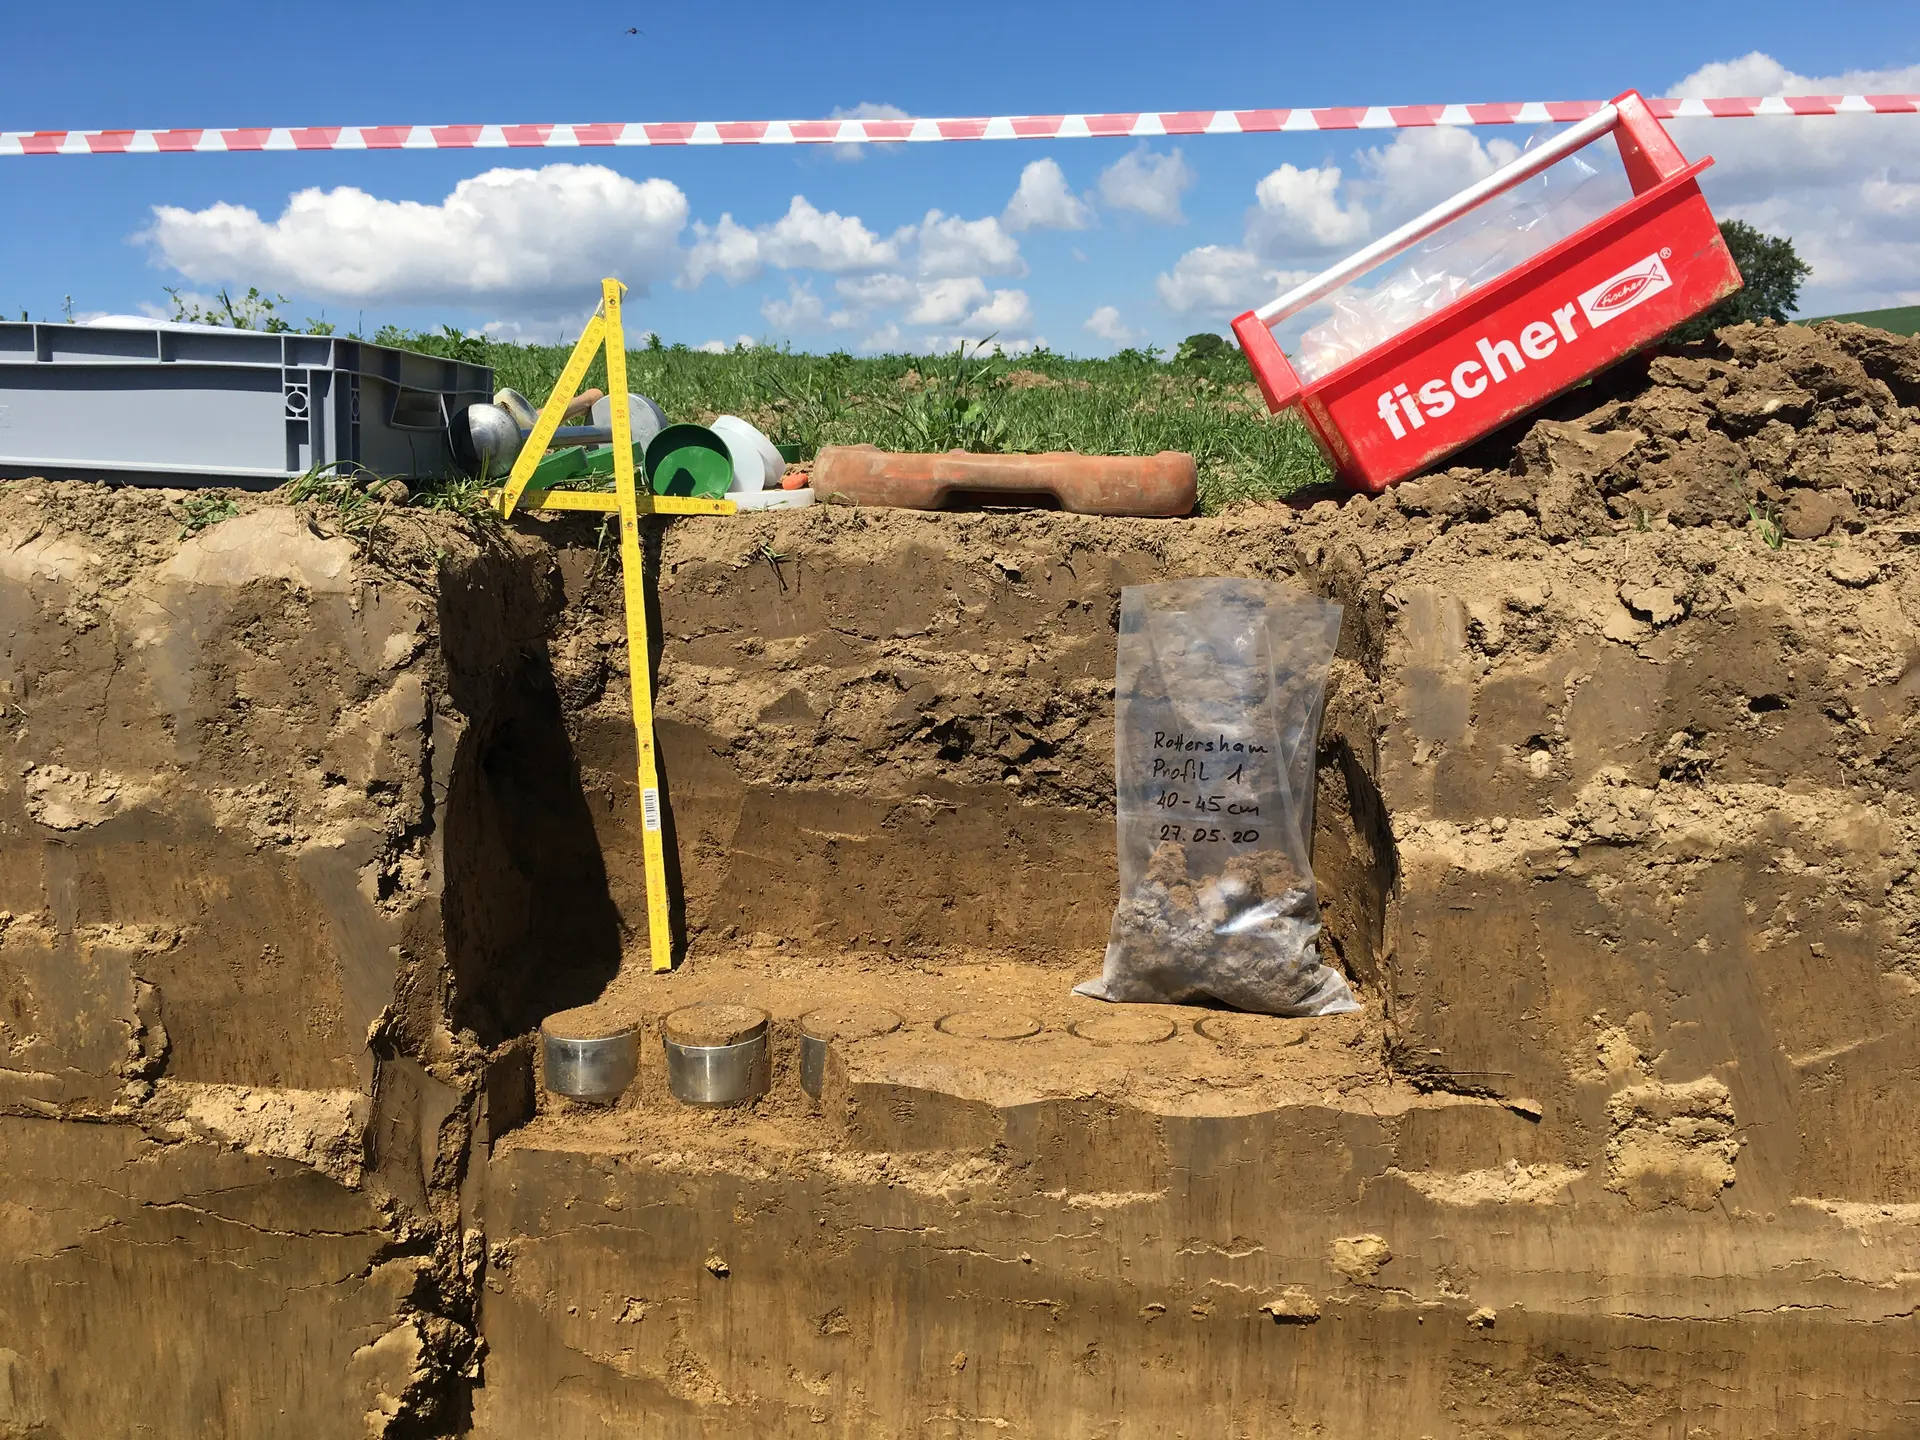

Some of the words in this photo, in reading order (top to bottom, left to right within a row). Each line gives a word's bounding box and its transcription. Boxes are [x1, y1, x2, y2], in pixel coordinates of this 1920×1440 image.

[1601, 279, 1647, 307] fischer
[1377, 301, 1580, 440] fischer
[1154, 732, 1268, 754] Rottersham
[1153, 759, 1209, 783] Profil
[1227, 763, 1243, 785] 1
